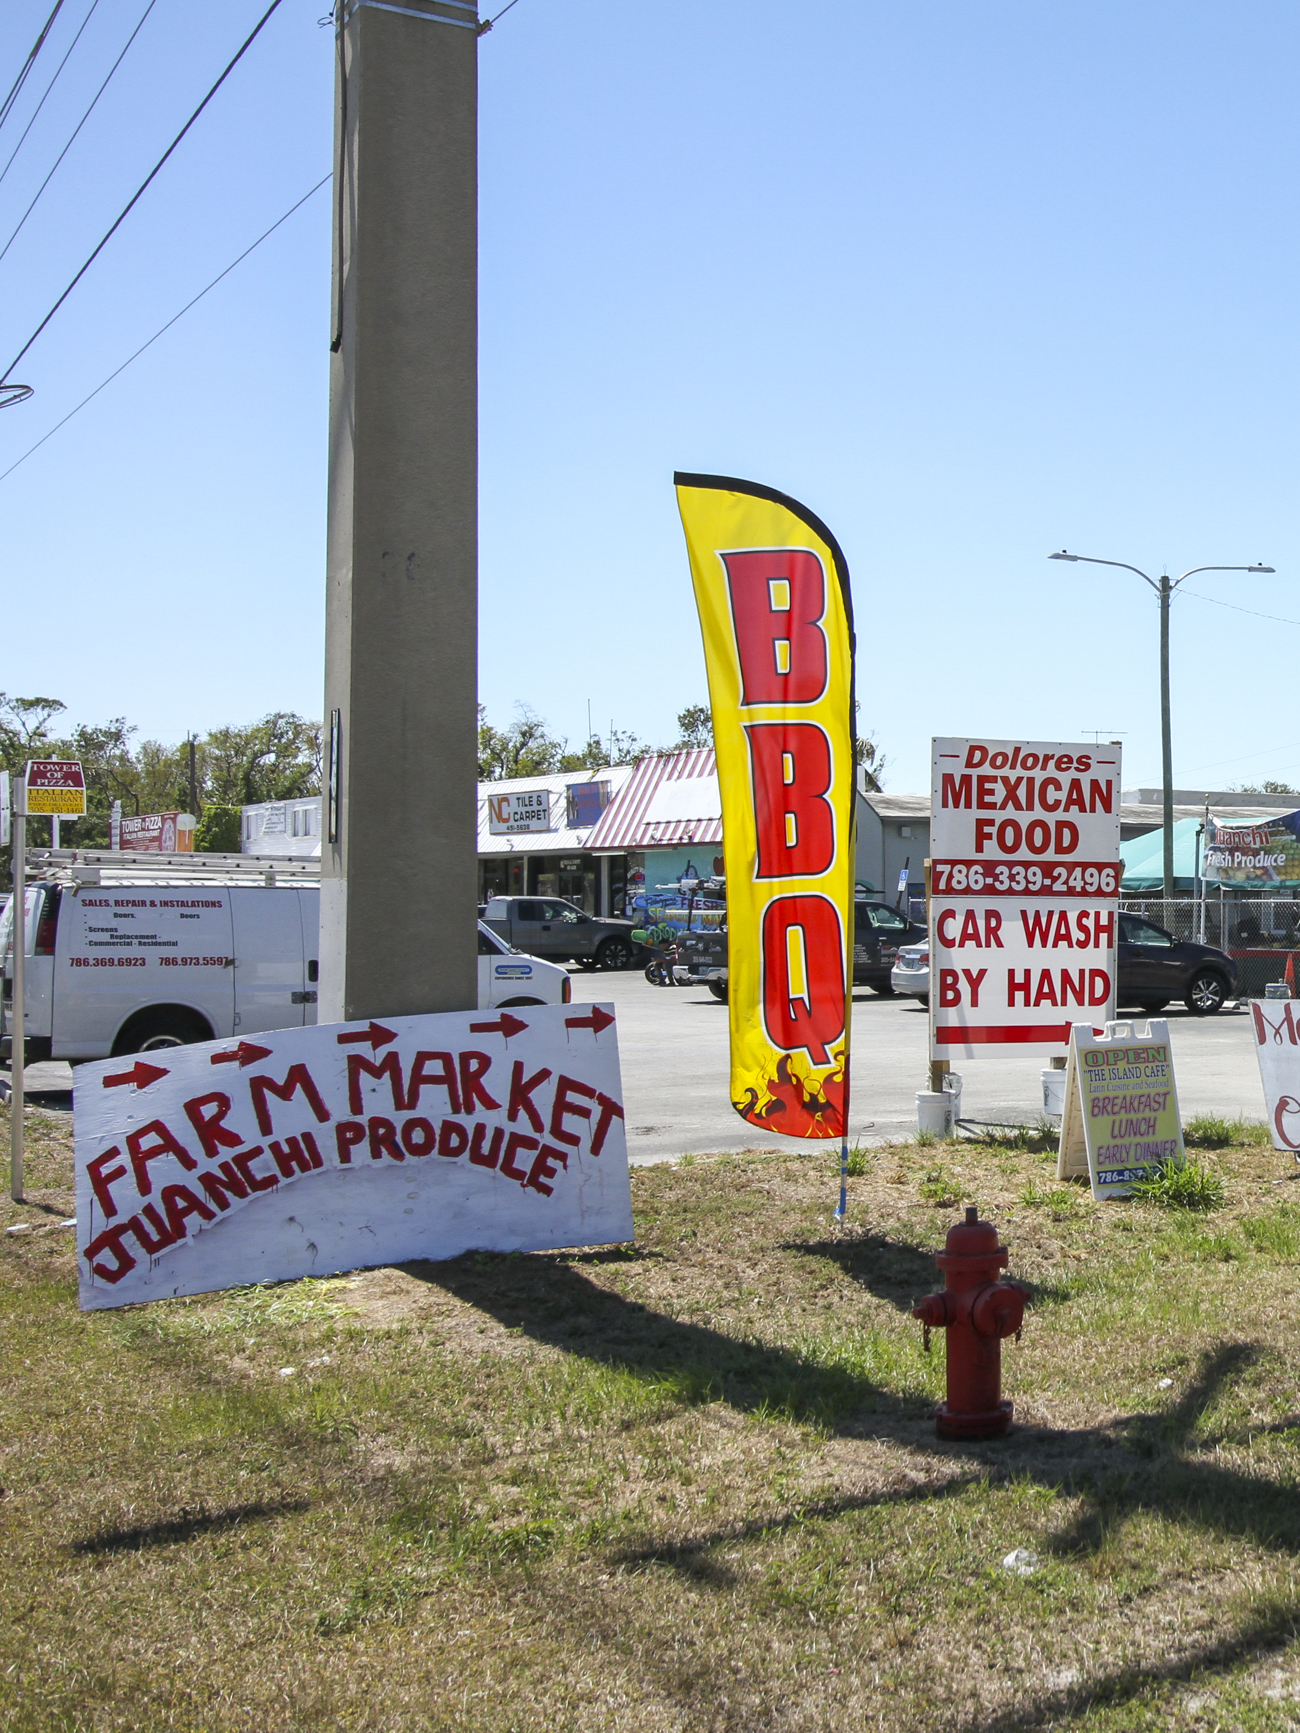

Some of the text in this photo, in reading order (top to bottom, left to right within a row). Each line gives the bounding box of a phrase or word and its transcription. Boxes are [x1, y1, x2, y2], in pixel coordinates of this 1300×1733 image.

[964, 745, 1092, 772] Dolores
[718, 546, 846, 1066] BBQ
[941, 773, 1112, 814] MEXICAN
[489, 795, 543, 824] NC TILE &
[513, 809, 547, 822] CARPET
[122, 819, 142, 833] TOWER
[145, 816, 162, 829] PIZZA
[975, 818, 1079, 855] FOOD
[1213, 824, 1271, 847] Juanchi
[1206, 850, 1286, 868] Fresh Produce
[936, 864, 1116, 892] 786-339-2496
[114, 900, 147, 908] REPAIR
[149, 900, 157, 908] &
[160, 900, 222, 908] INSTALATIONS
[681, 898, 719, 910] FRESH
[937, 908, 1114, 949] CAR WASH
[69, 957, 229, 967] 786.369.6923 786.973.5597
[939, 968, 1111, 1008] BY HAND
[1085, 1046, 1167, 1067] OPEN
[1084, 1069, 1106, 1082] "THE
[1108, 1066, 1142, 1080] ISLAND
[1089, 1077, 1169, 1093] Latin Cuisine and Seafood
[1091, 1091, 1171, 1118] BREAKFAST
[86, 1051, 624, 1218] FARM MARKET
[1110, 1116, 1157, 1140] LUNCH
[1097, 1139, 1178, 1166] EARLY DINNER
[83, 1116, 569, 1284] JUANCHI PRODUCE
